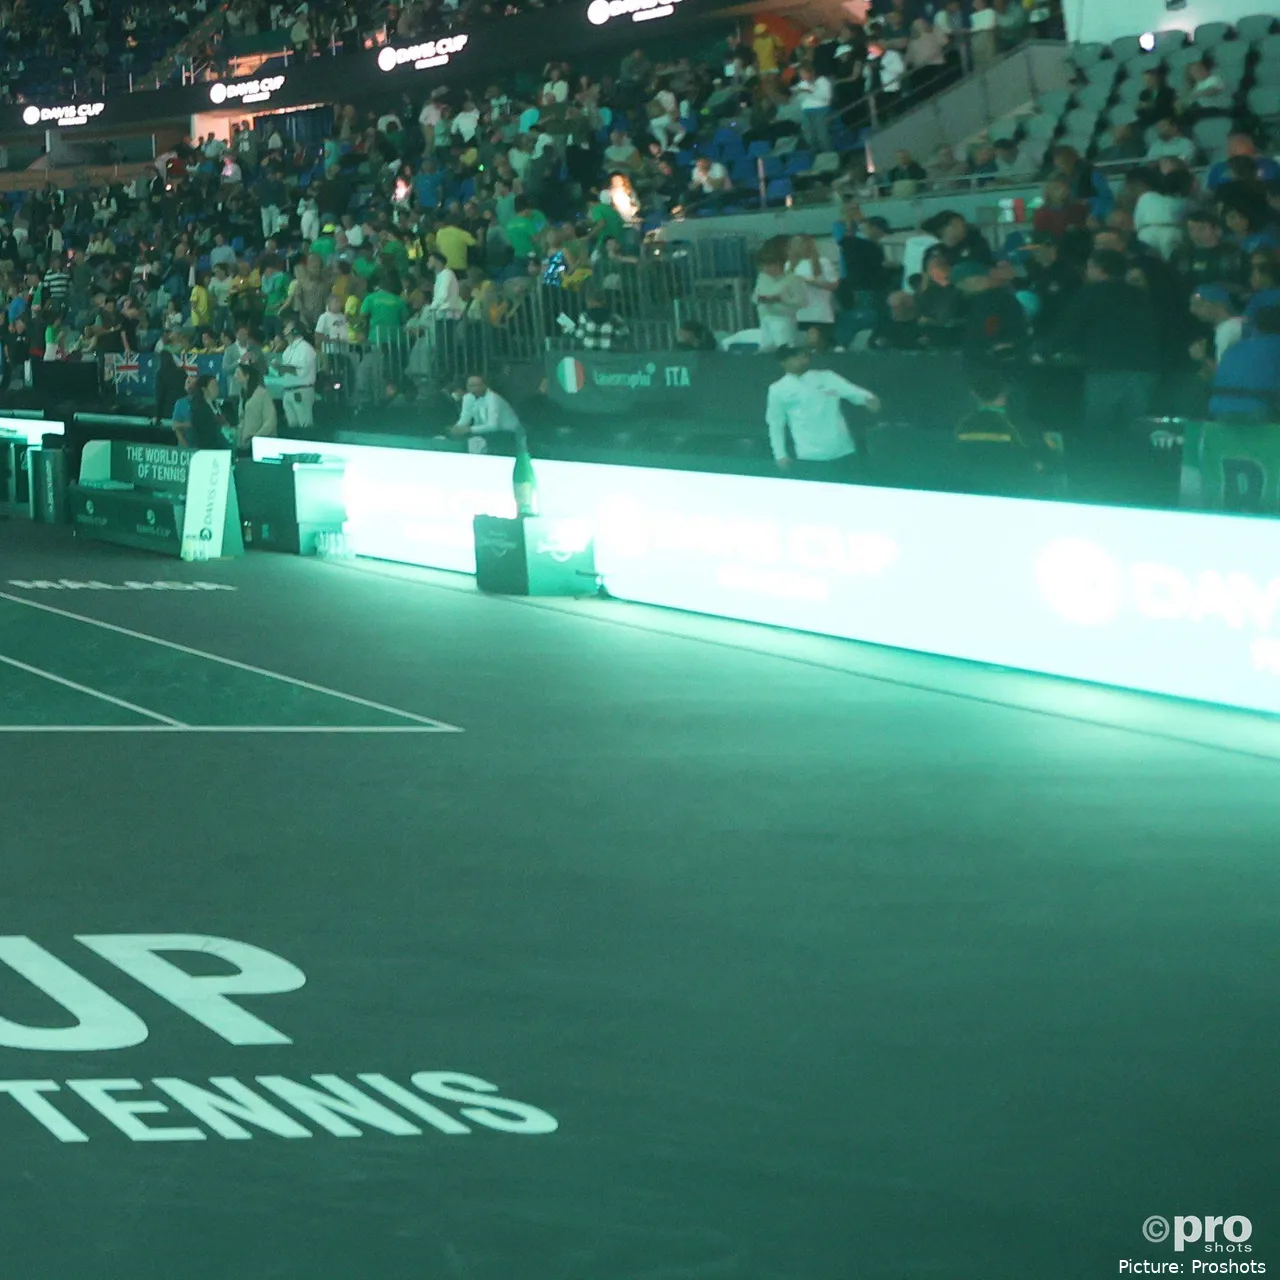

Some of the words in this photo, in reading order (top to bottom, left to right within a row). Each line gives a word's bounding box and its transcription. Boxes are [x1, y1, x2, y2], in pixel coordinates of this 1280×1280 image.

[665, 366, 691, 387] ITA
[126, 447, 144, 461] THE
[145, 450, 179, 466] WORLD
[137, 465, 150, 479] OF
[151, 465, 187, 483] TENNIS
